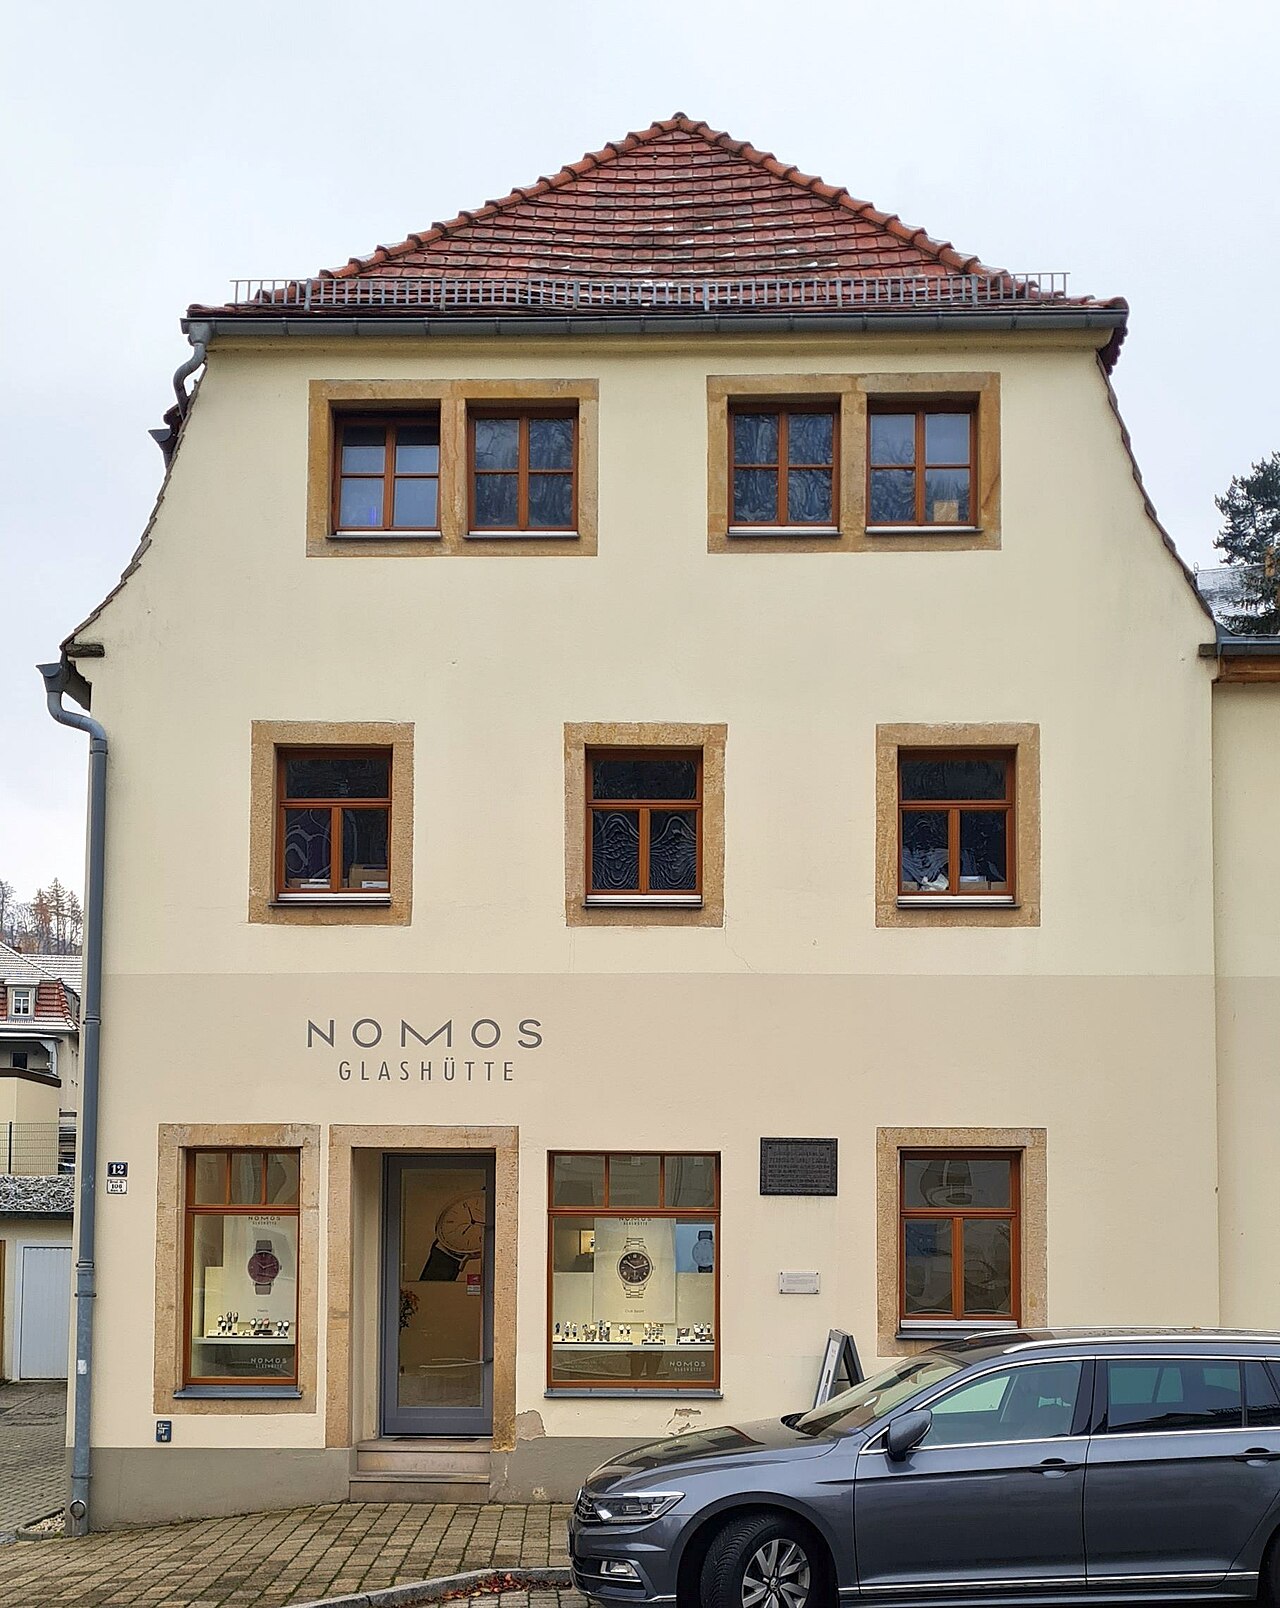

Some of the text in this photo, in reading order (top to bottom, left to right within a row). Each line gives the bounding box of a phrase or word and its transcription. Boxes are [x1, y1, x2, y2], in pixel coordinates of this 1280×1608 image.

[307, 1018, 543, 1049] NOMOS
[338, 1057, 514, 1081] GLASHÜTTE
[111, 1164, 125, 1175] 12
